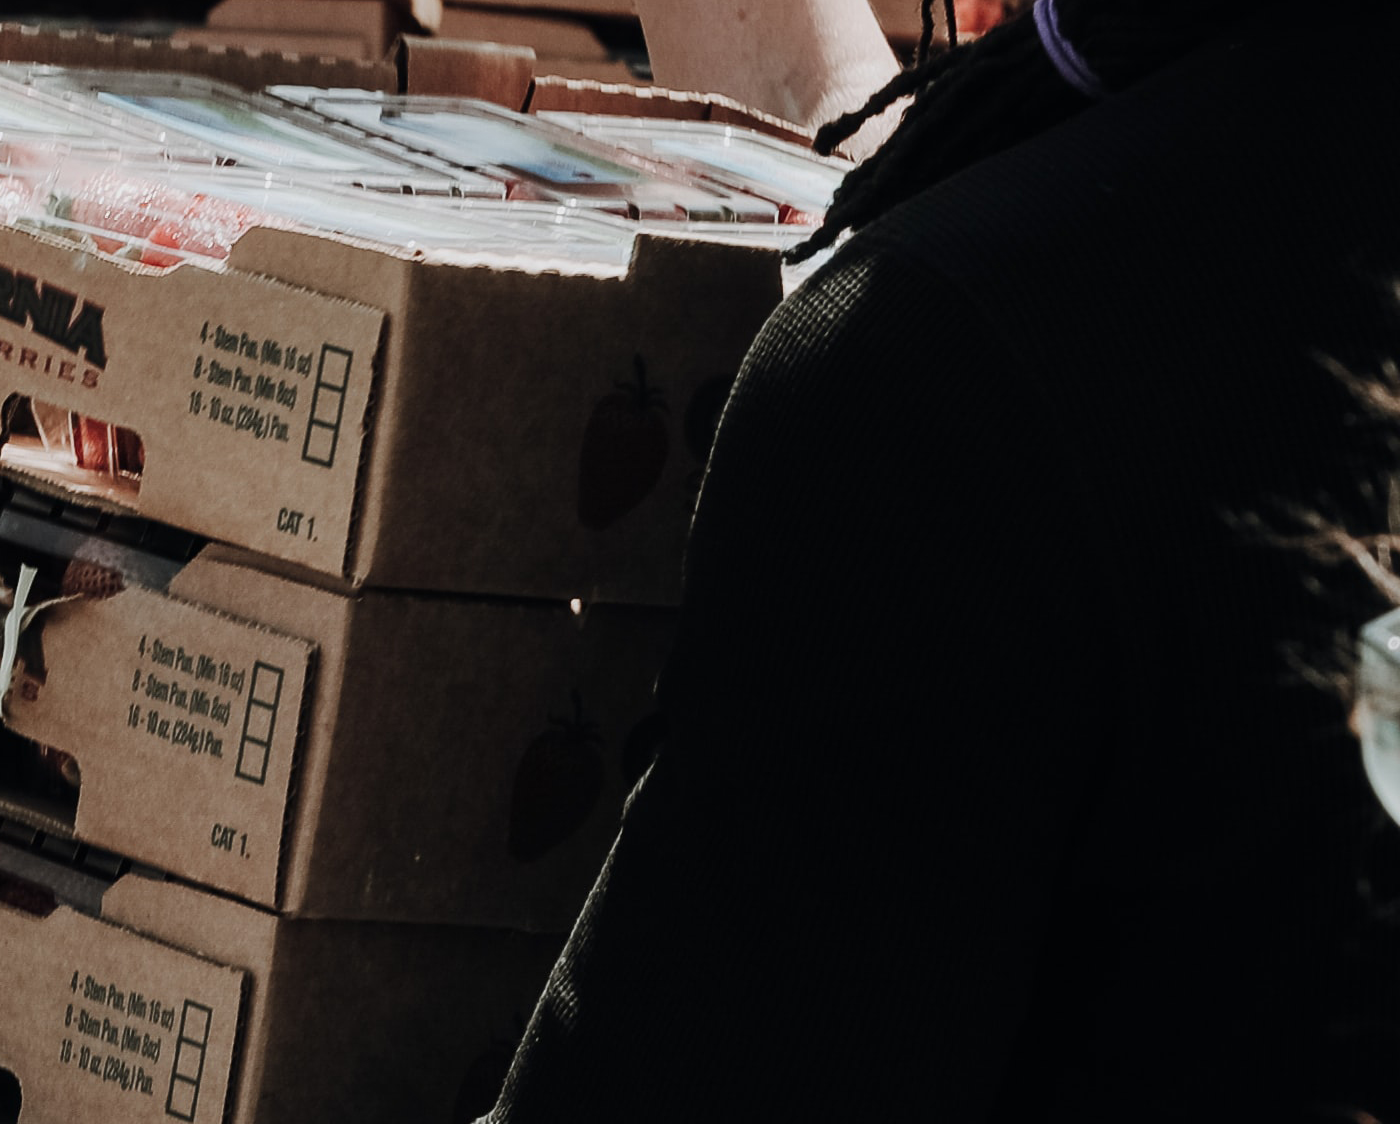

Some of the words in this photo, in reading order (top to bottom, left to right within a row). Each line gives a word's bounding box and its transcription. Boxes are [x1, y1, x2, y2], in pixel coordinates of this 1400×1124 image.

[277, 507, 304, 536] CAT
[307, 516, 318, 542] 1.
[211, 823, 237, 852] CAT
[240, 832, 250, 860] 1.
